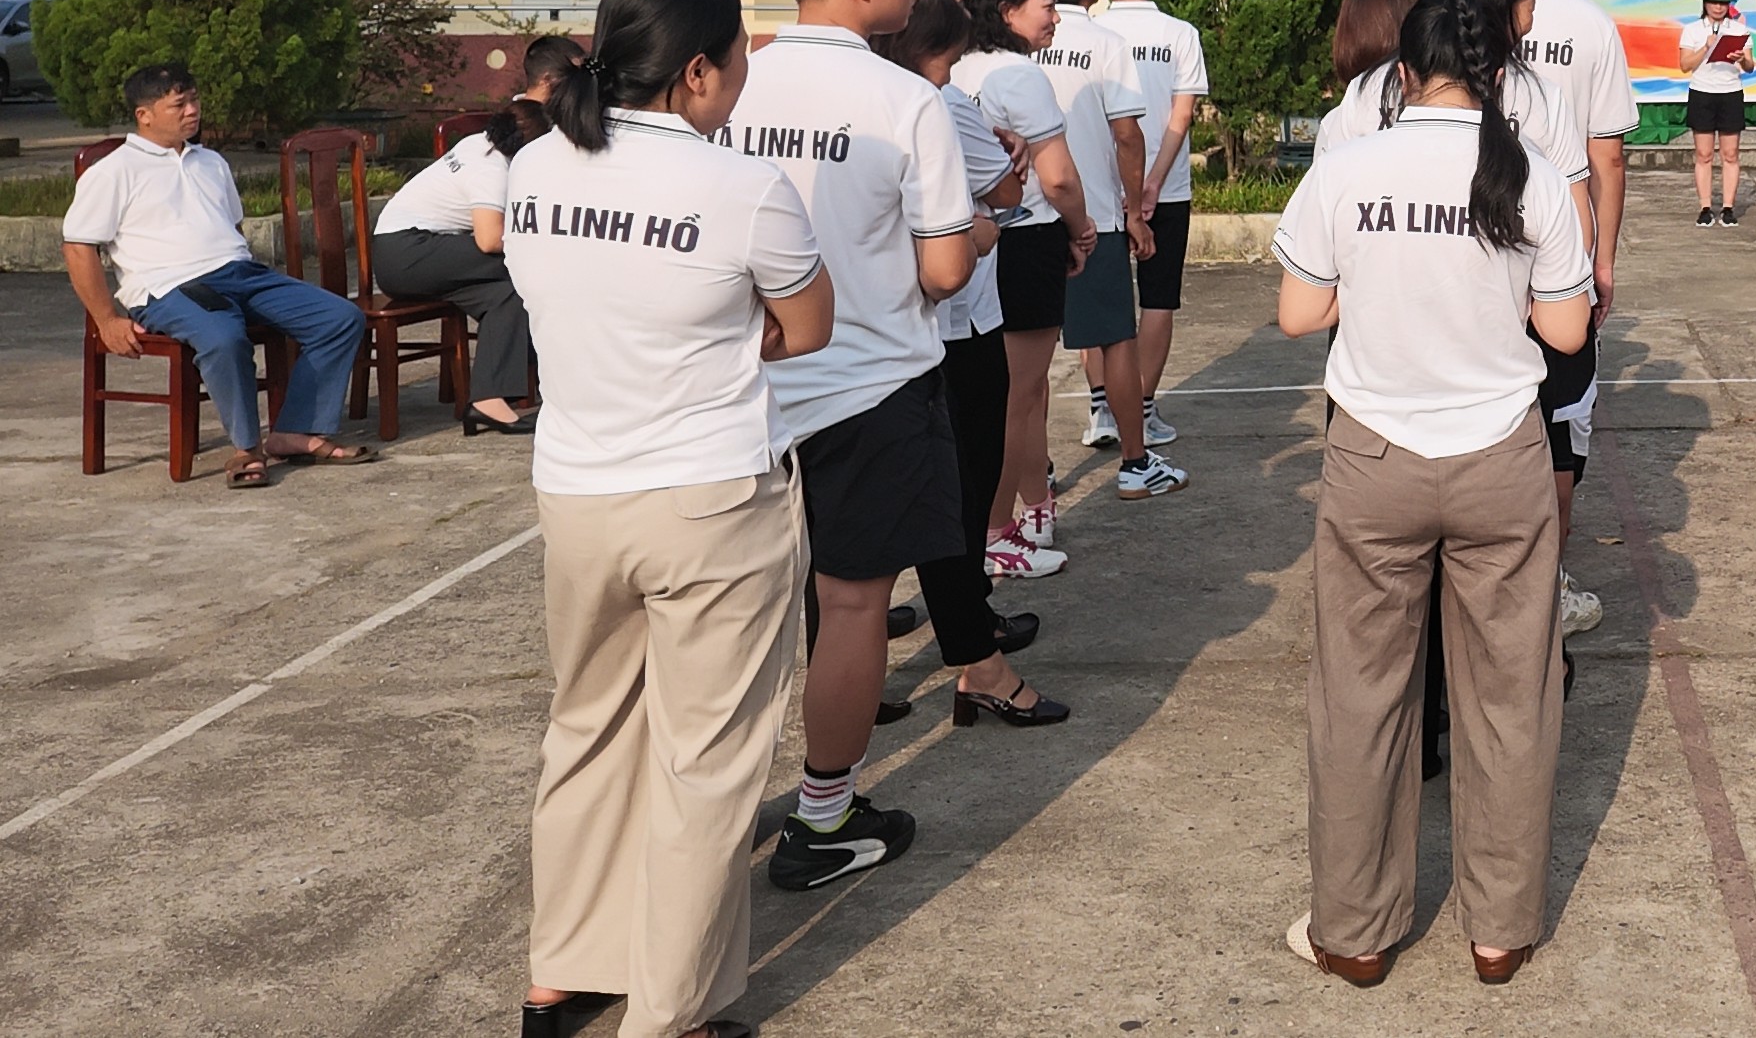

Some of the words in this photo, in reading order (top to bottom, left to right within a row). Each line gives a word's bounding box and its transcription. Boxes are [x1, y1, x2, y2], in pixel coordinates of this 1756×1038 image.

[1027, 48, 1064, 66] INH
[1067, 50, 1092, 70] HỒ
[1152, 43, 1172, 63] HỒ
[1545, 37, 1574, 66] HỒ
[744, 126, 805, 159] LINH
[812, 122, 852, 163] HỒ
[511, 195, 539, 234] XÃ
[551, 204, 635, 244] LINH
[643, 212, 702, 253] HỒ
[1357, 195, 1396, 232] XÃ
